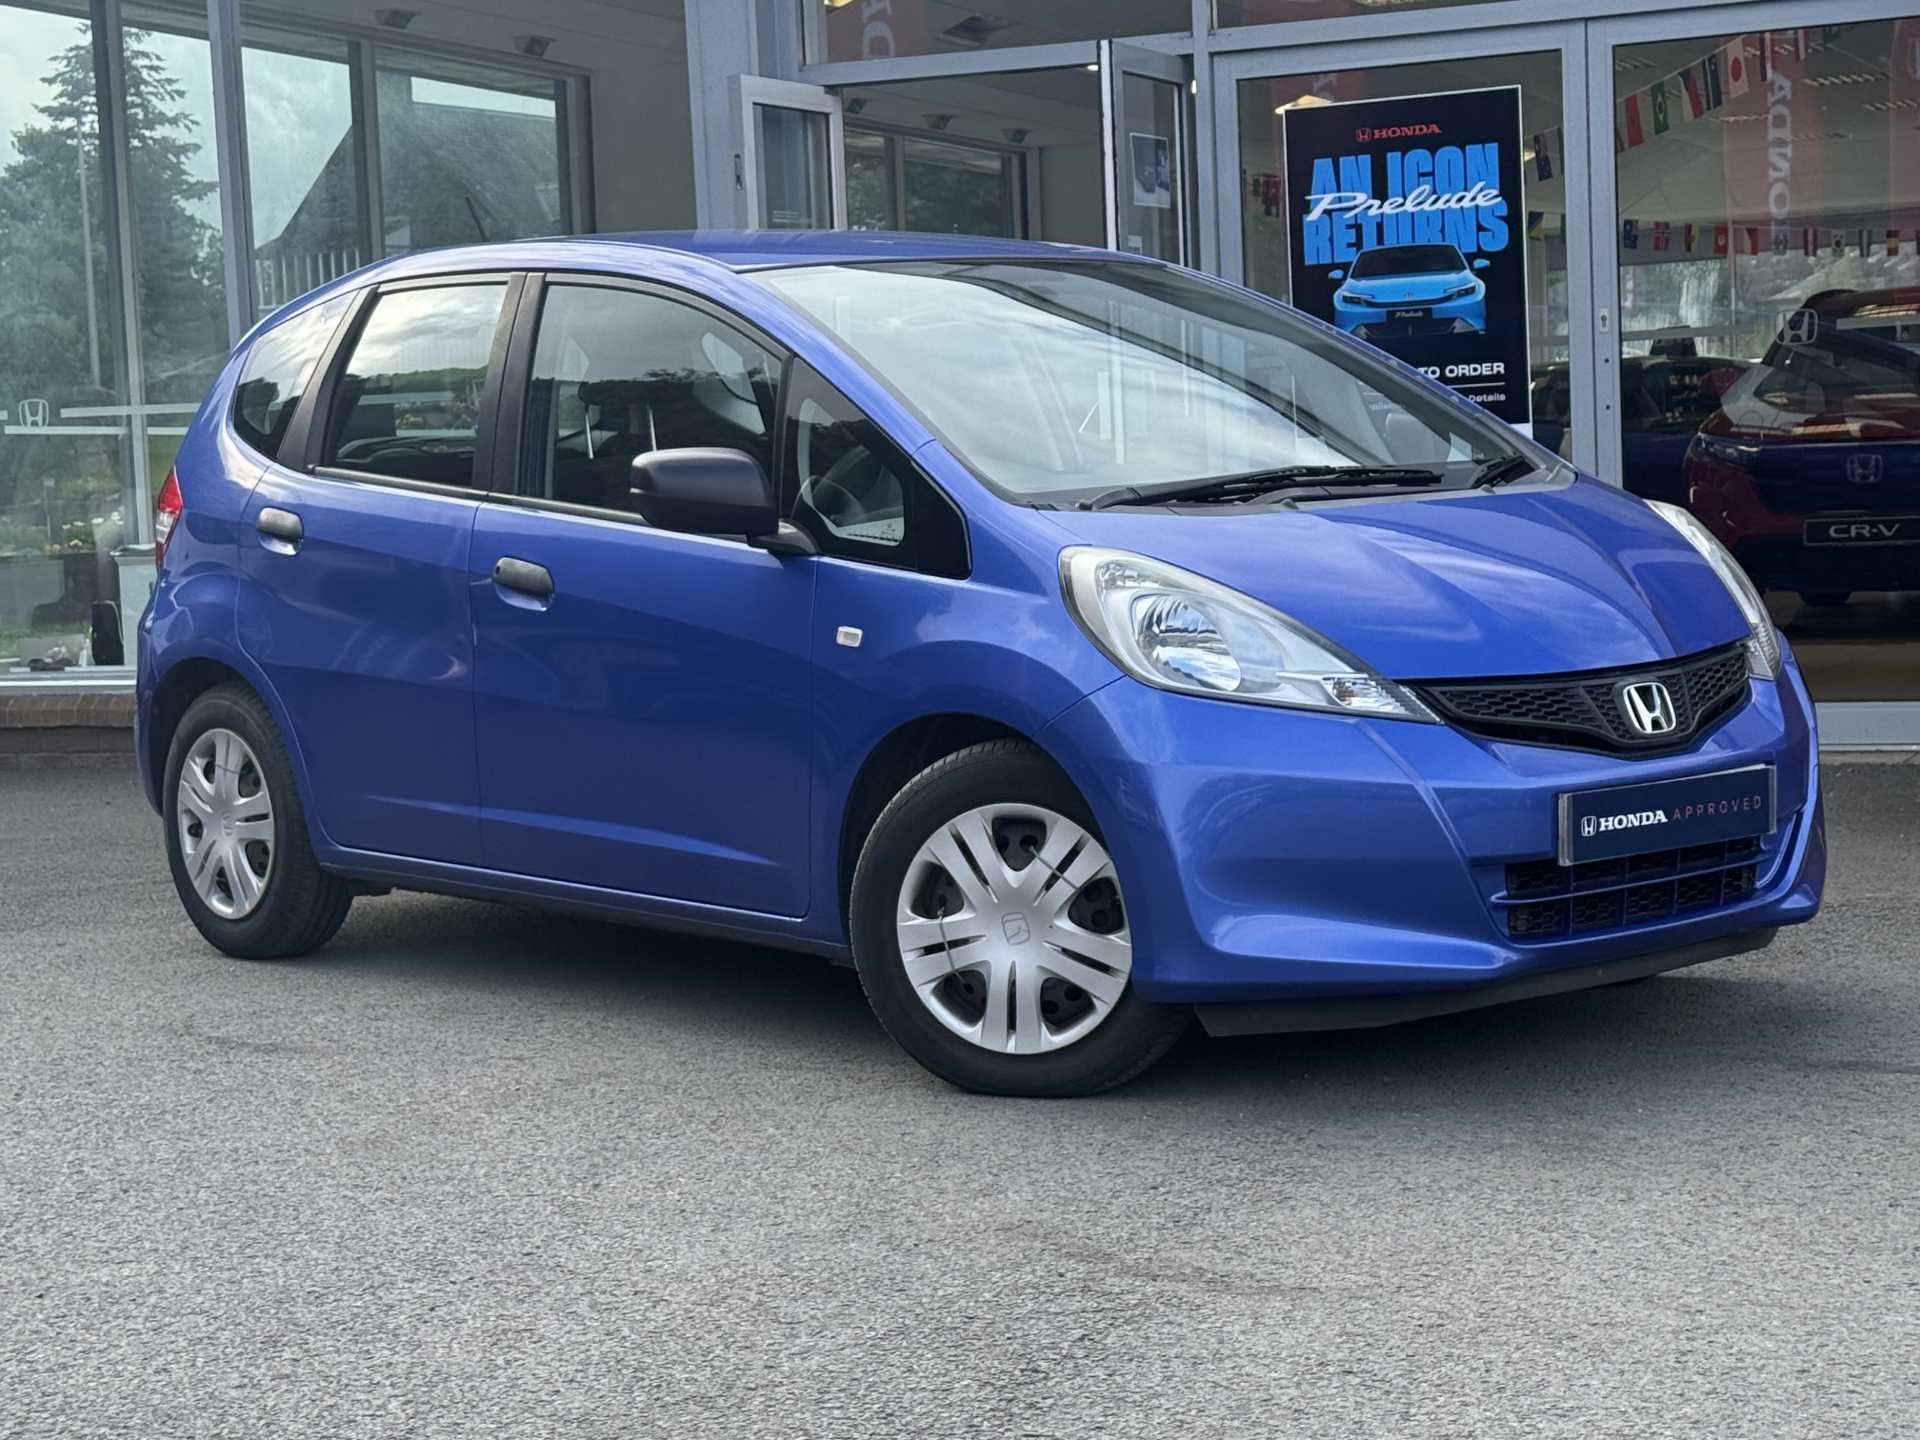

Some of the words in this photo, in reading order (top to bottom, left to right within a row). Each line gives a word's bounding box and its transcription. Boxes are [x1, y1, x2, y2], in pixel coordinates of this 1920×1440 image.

[1373, 123, 1442, 139] HONDA
[1309, 154, 1373, 210] AN
[1386, 142, 1500, 199] ICON
[1304, 181, 1503, 221] Prelude
[1302, 199, 1509, 266] RETURNS
[1417, 366, 1441, 379] TO
[1445, 362, 1505, 378] ORDER
[1830, 523, 1900, 538] CR-V
[1598, 809, 1668, 832] HONDA
[1672, 795, 1762, 820] APPROVED
